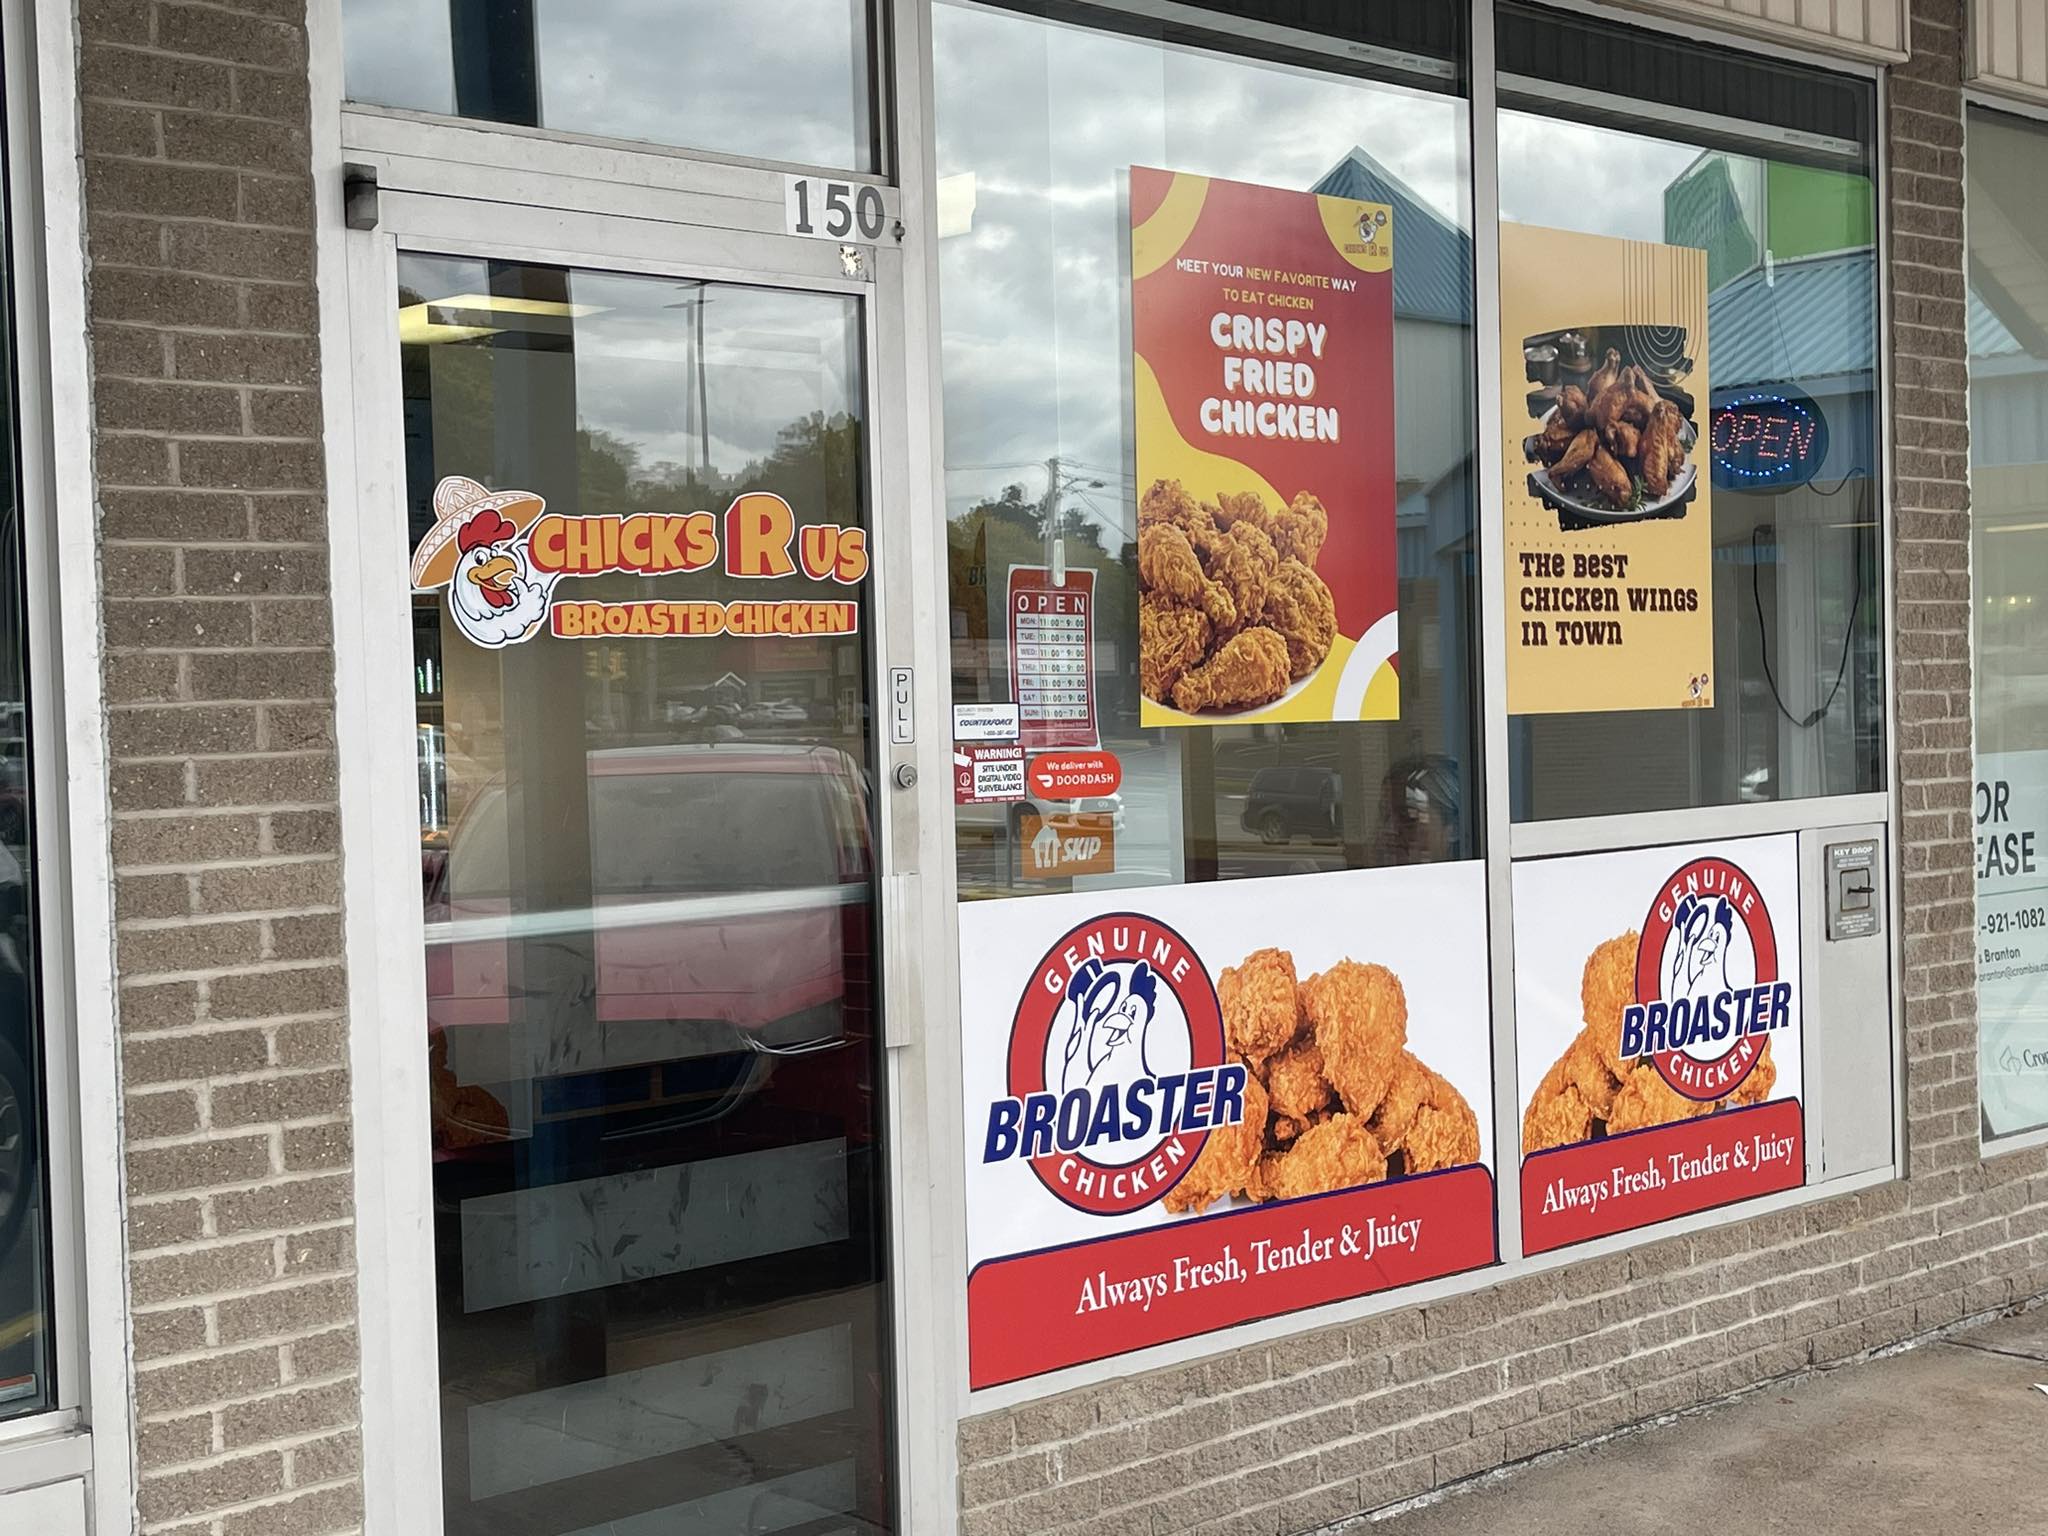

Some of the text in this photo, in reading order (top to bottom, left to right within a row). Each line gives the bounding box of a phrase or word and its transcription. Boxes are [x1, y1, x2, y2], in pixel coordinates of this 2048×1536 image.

[794, 180, 884, 239] 150
[1176, 258, 1357, 292] MEET YOUR NEW FAVORITE WAY
[1223, 288, 1314, 310] TO EAT CHICKEN
[1210, 312, 1327, 358] CRISPY
[1223, 356, 1315, 398] FRIED
[1199, 397, 1340, 442] CHICKEN
[1712, 411, 1816, 459] OPEN
[529, 493, 867, 582] CHICKS R US
[1018, 595, 1085, 613] OPEN
[896, 673, 908, 739] PULL
[960, 718, 1014, 727] COUNTERFORCE
[974, 747, 1022, 760] WARNING!
[982, 763, 1018, 772] SITE UNDER
[1047, 759, 1104, 770] We deliver with
[978, 773, 1022, 782] DIGITAL VIDEO
[978, 783, 1023, 792] SURVEILLANCE
[1056, 773, 1114, 786] DOORDASH
[1061, 836, 1102, 862] SKIP
[1834, 846, 1873, 856] KEY DROP
[1658, 867, 1757, 925] GENUINE
[1978, 907, 2046, 936] -921-1082
[1044, 926, 1193, 996] GENUINE
[1984, 946, 2021, 963] Branton
[1620, 981, 1792, 1058] BROASTER
[1669, 1039, 1754, 1089] CHICKEN
[2023, 1049, 2048, 1068] Cro
[983, 1064, 1248, 1164] BROASTER
[1057, 1136, 1187, 1200] CHICKEN
[1541, 1132, 1795, 1215] Always Fresh, Tender & Juicy
[1075, 1214, 1423, 1315] Always Fresh, Tender & Juicy
